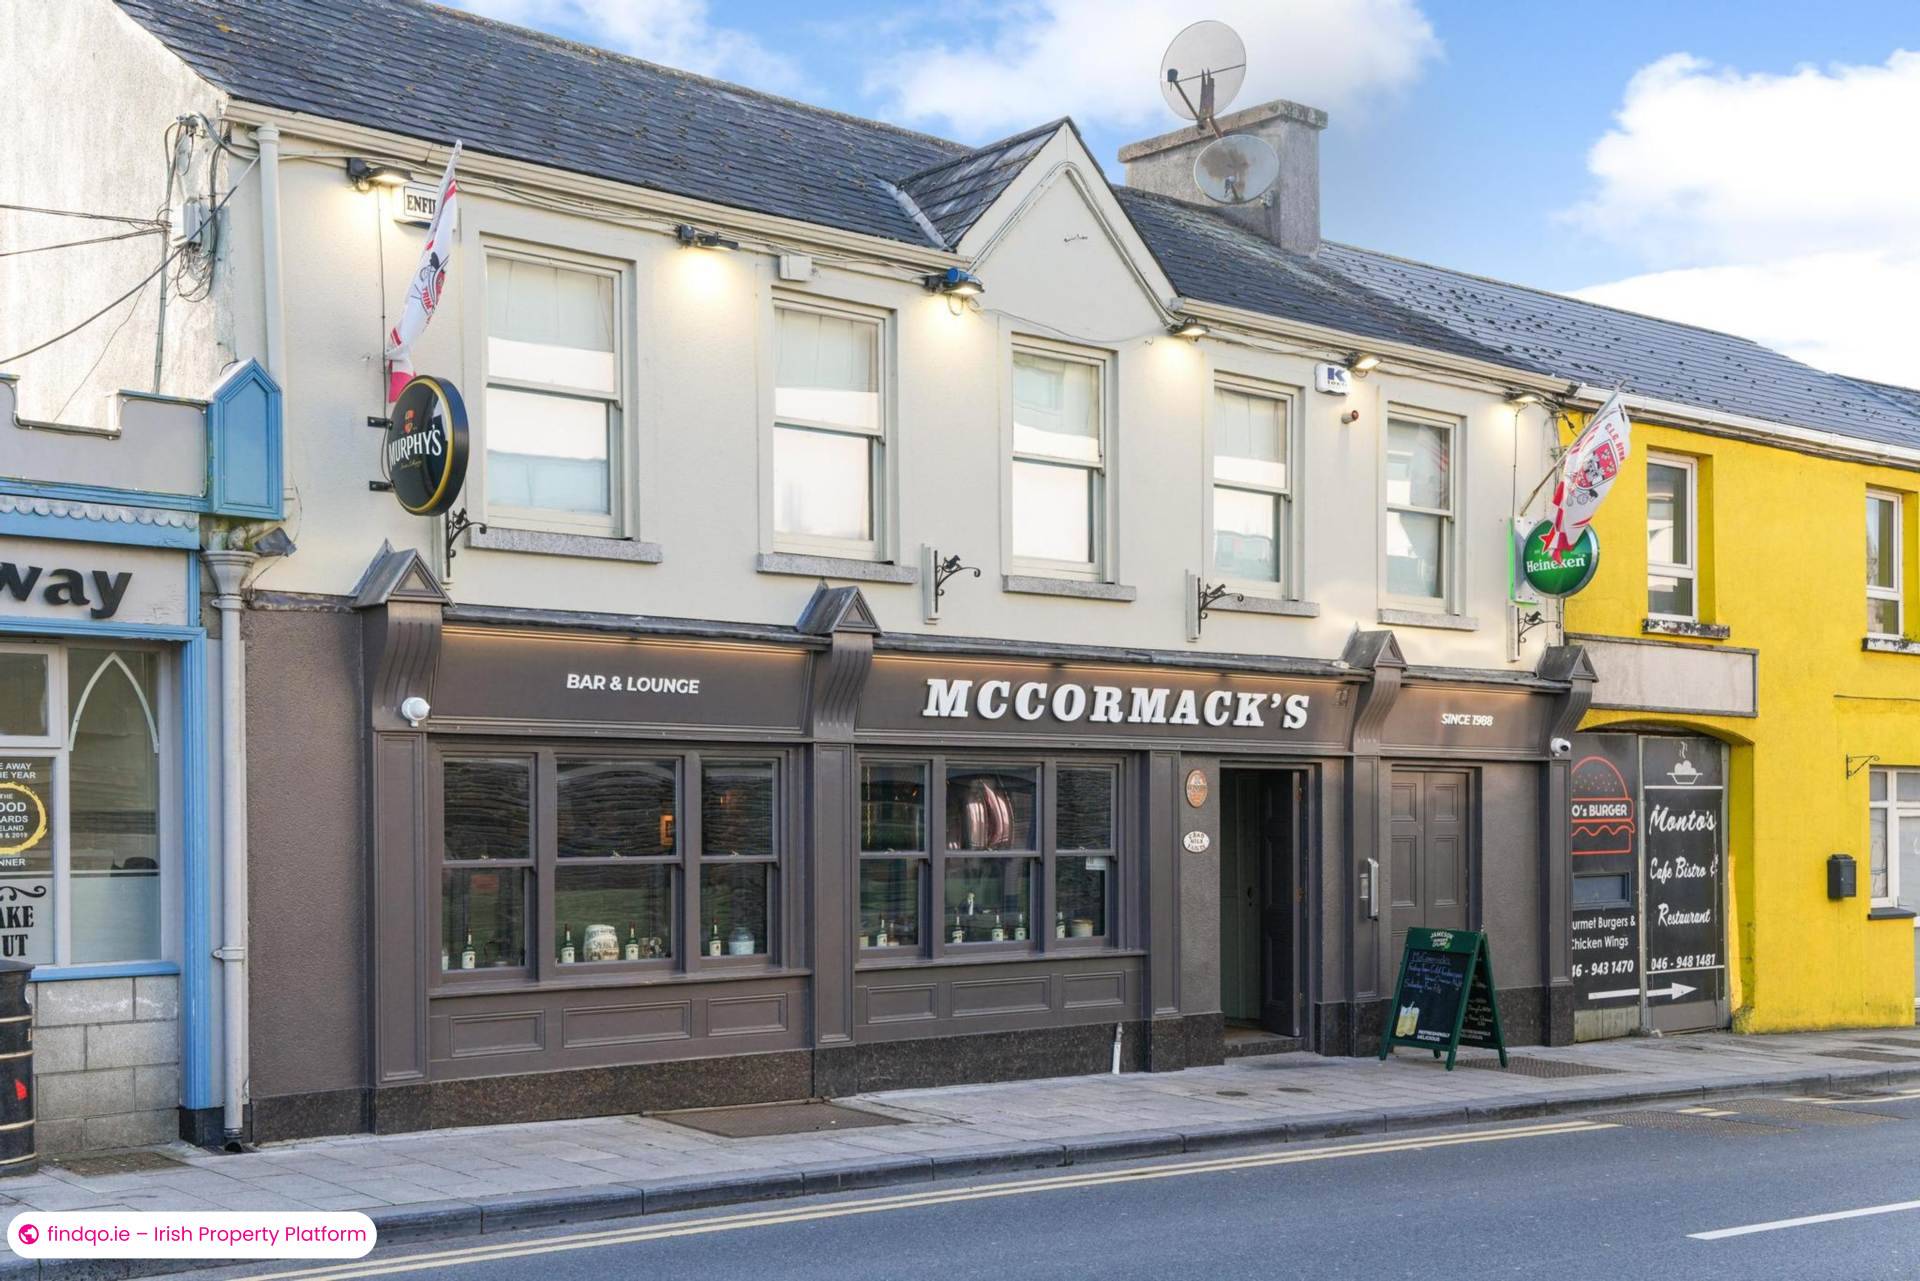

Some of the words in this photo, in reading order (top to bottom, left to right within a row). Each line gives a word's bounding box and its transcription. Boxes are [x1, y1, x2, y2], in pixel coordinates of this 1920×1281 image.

[388, 424, 442, 471] MURPHY'S
[0, 562, 133, 619] way
[567, 673, 606, 690] BAR
[609, 676, 622, 691] &
[627, 676, 700, 694] LOUNGE
[923, 678, 1310, 730] MCCORMACK'S
[1441, 713, 1471, 726] SINCE
[1472, 714, 1494, 727] 1988
[5, 762, 32, 770] AWAY
[10, 771, 36, 779] YEAR
[1589, 804, 1628, 817] BURGER
[1649, 804, 1717, 835] Monto's
[1650, 856, 1673, 884] Cafe
[1675, 855, 1706, 878] Bistro
[1598, 916, 1629, 930] Burgers
[1630, 915, 1636, 927] &
[1657, 902, 1712, 926] Restaurant
[1604, 935, 1629, 949] Wings
[1591, 961, 1609, 976] 943
[1611, 959, 1635, 974] 1470
[1651, 957, 1669, 970] 046
[1676, 955, 1694, 969] 948
[1696, 953, 1716, 967] 1481
